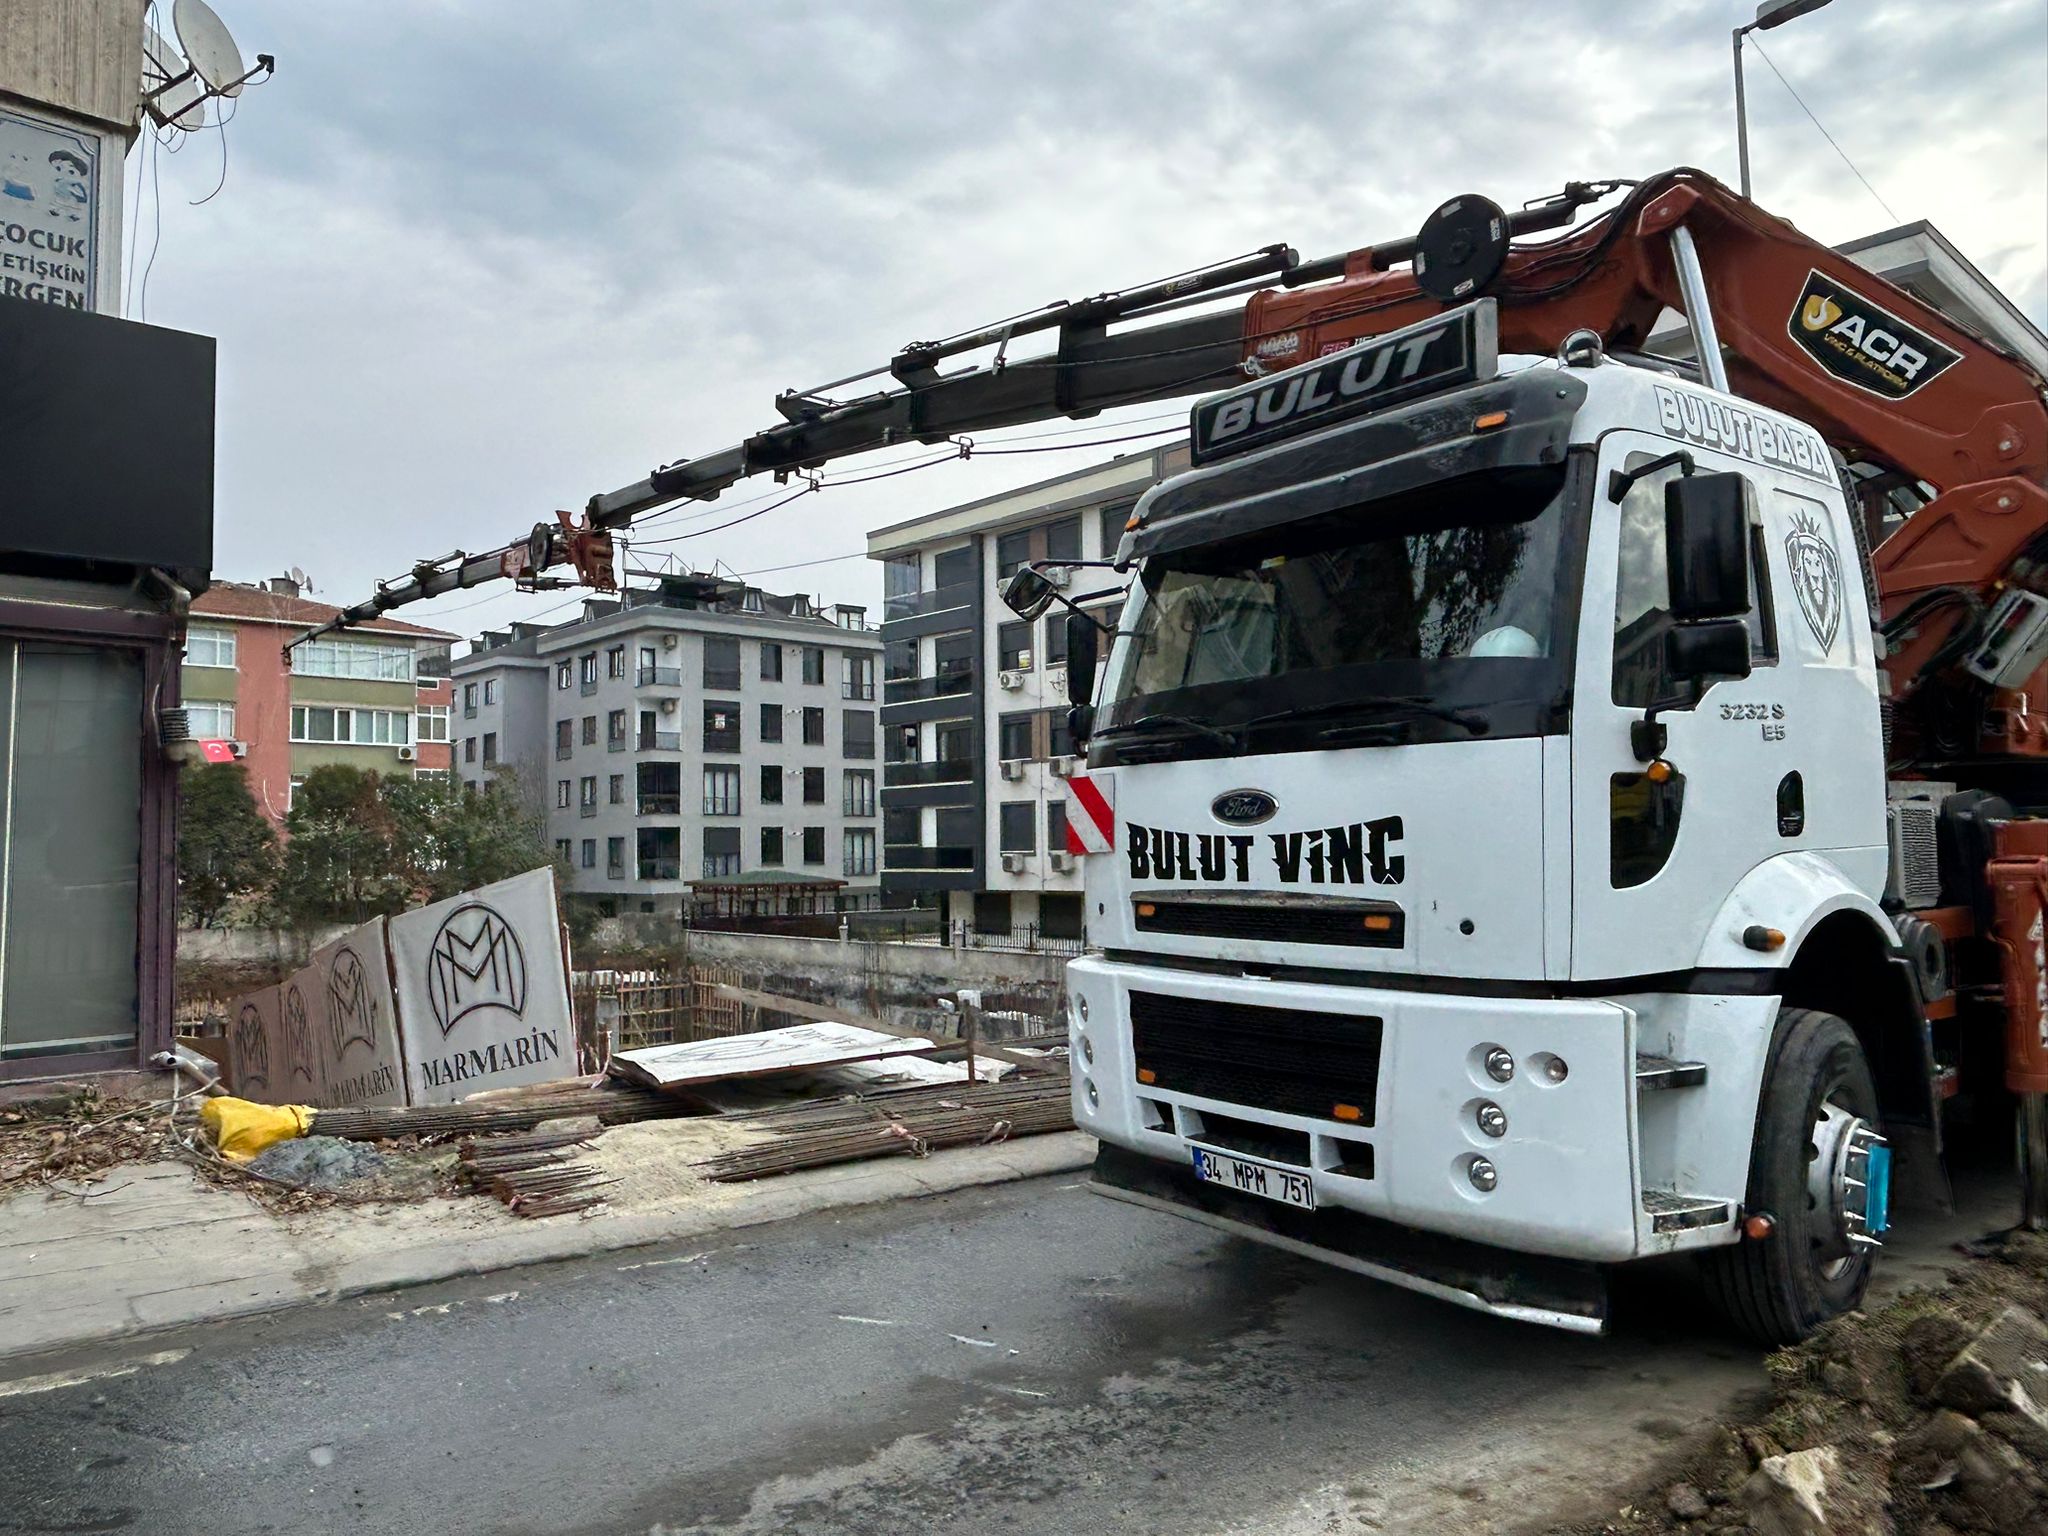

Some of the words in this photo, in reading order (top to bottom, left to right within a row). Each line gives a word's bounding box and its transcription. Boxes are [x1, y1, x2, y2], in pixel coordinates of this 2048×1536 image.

[0, 220, 85, 258] OCUK
[0, 252, 85, 284] ETİŞKİN
[0, 276, 84, 309] RGEN
[1829, 314, 1928, 380] ACR
[1208, 327, 1448, 442] BULUT
[1653, 384, 1754, 459] BULUT
[1753, 416, 1833, 483] BABA
[1719, 703, 1769, 720] 3232
[1771, 703, 1785, 720] S
[1761, 723, 1786, 741] E5
[1126, 821, 1254, 882] BULUT
[421, 1026, 561, 1090] MARMARİN
[1202, 1153, 1223, 1182] 34
[1231, 1160, 1268, 1195] MPM
[1278, 1173, 1311, 1206] 751
